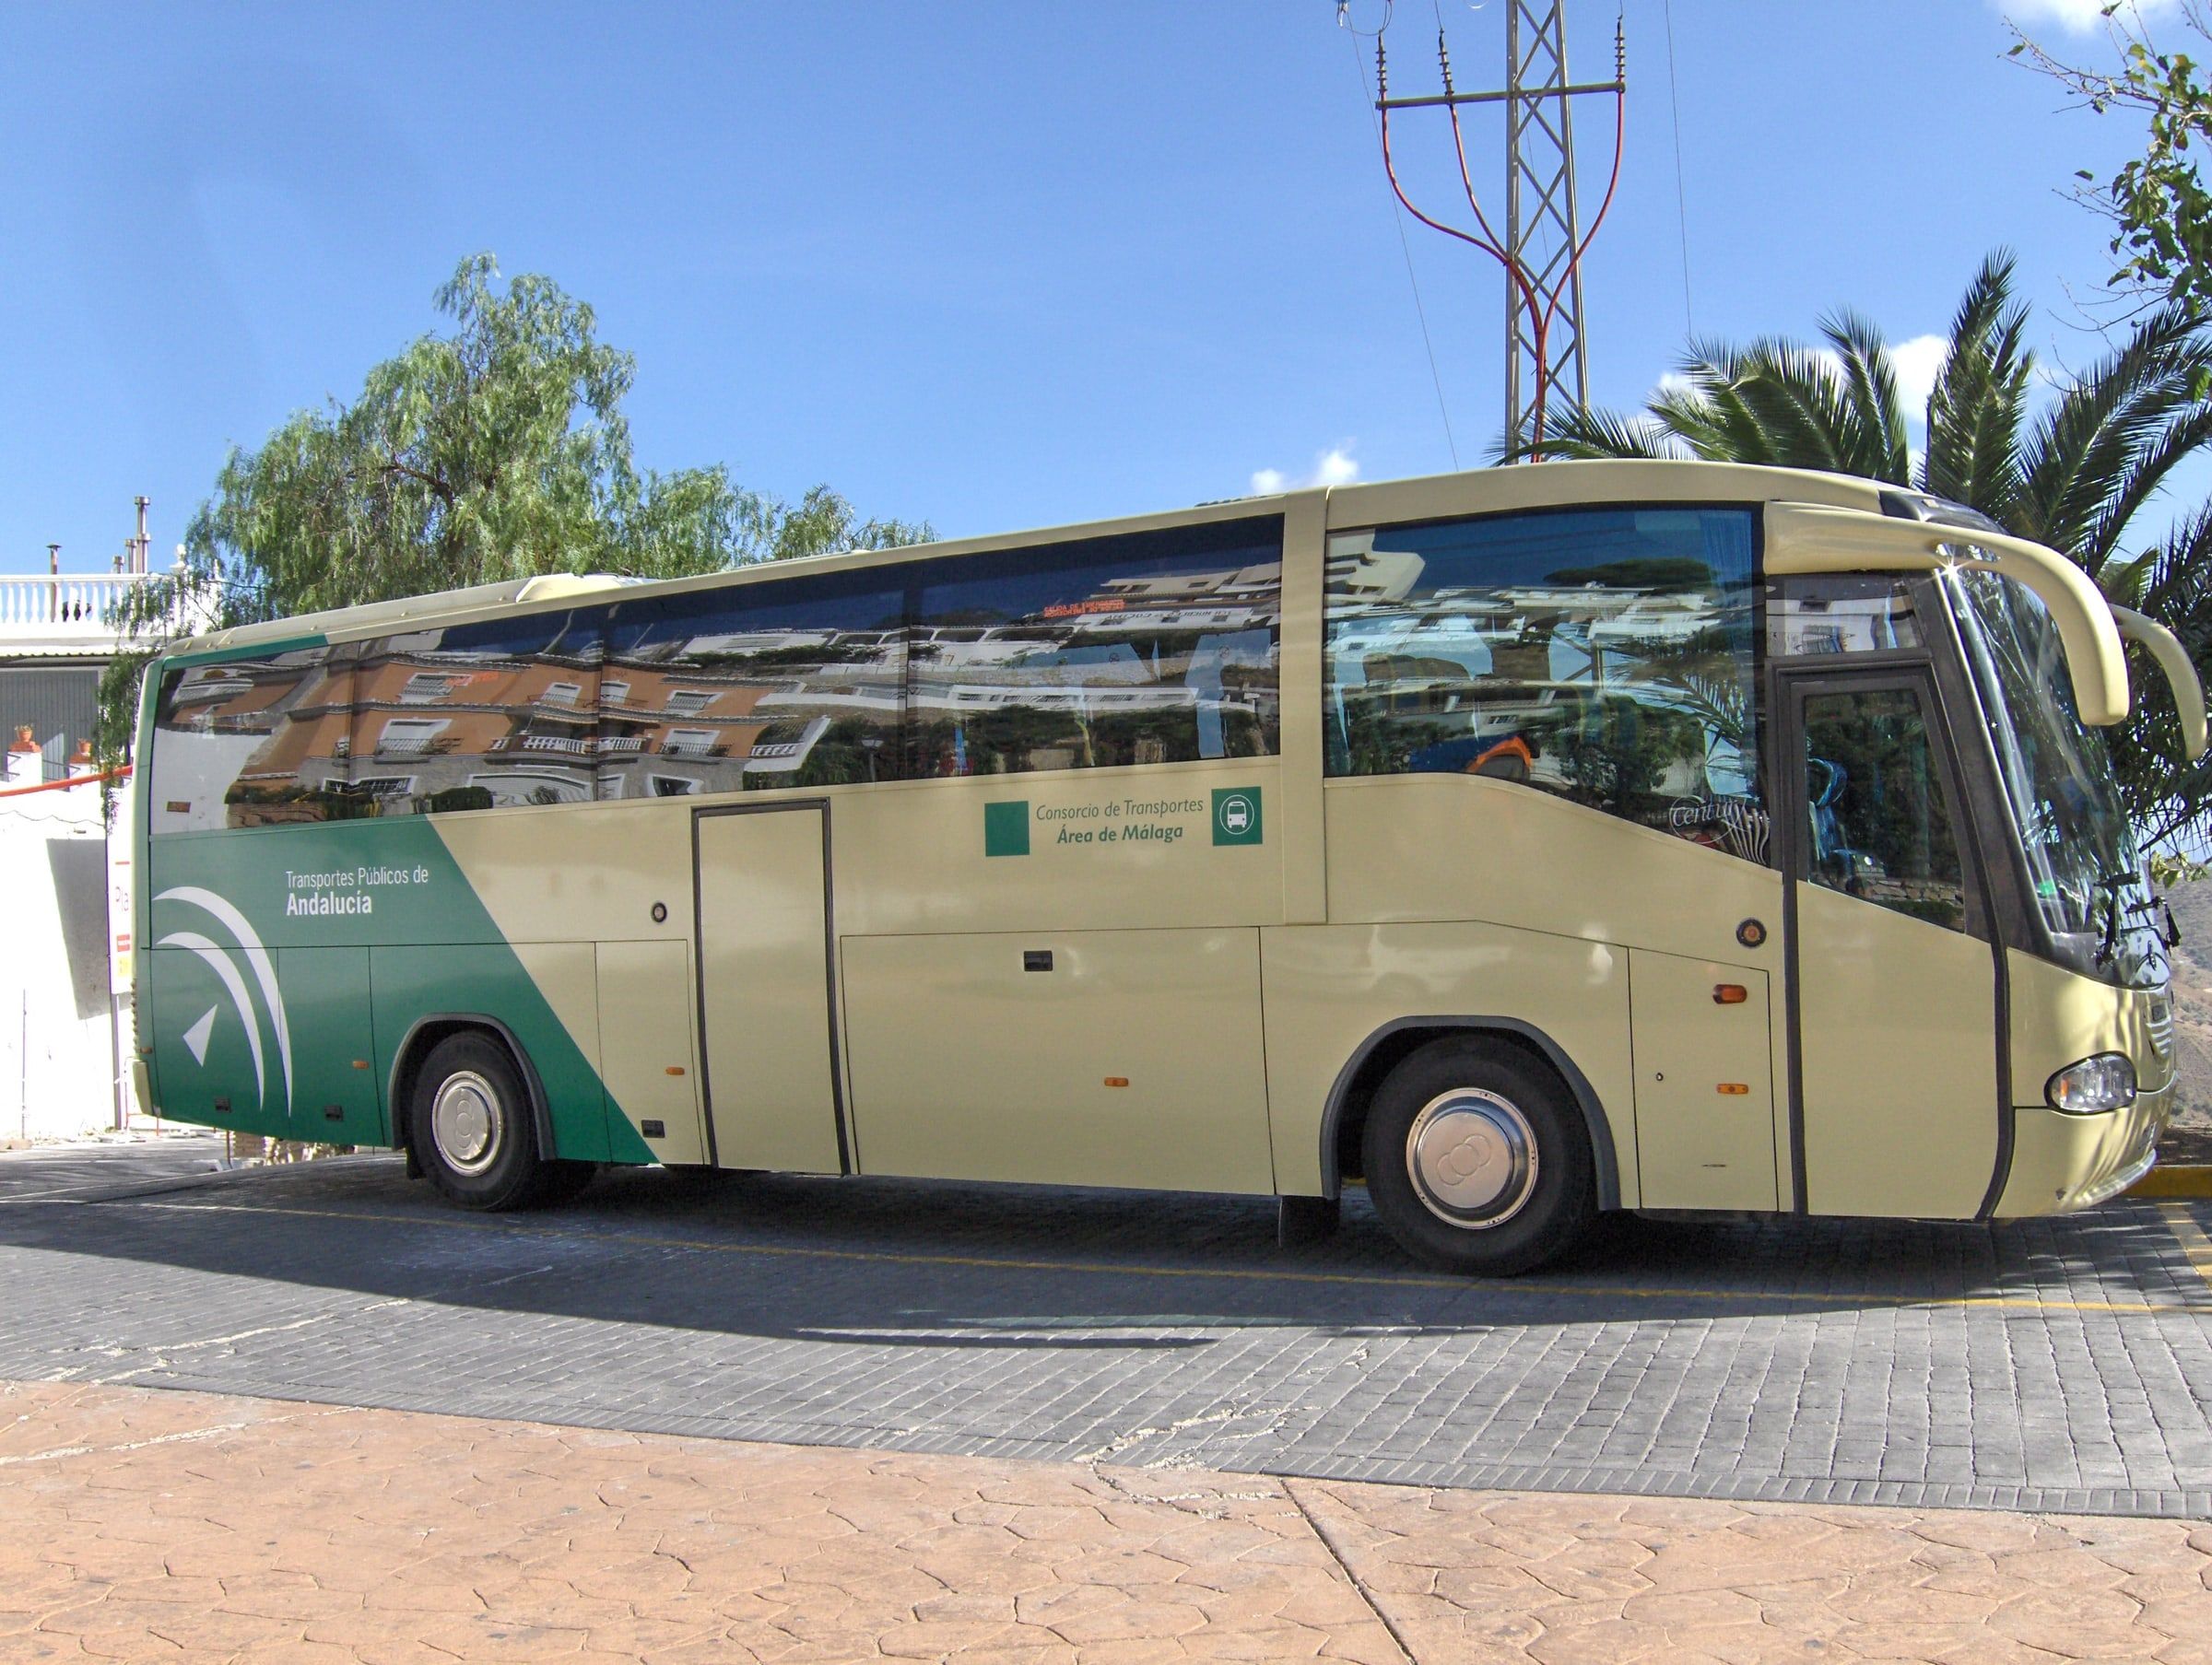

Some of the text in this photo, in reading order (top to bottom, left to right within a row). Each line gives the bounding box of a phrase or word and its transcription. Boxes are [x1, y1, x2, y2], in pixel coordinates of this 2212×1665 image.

[1036, 799, 1204, 820] Consorcio de Transportes
[1057, 824, 1183, 844] Área de Málaga
[286, 864, 429, 890] Transportes Públicos de
[286, 890, 372, 916] Andalucía
